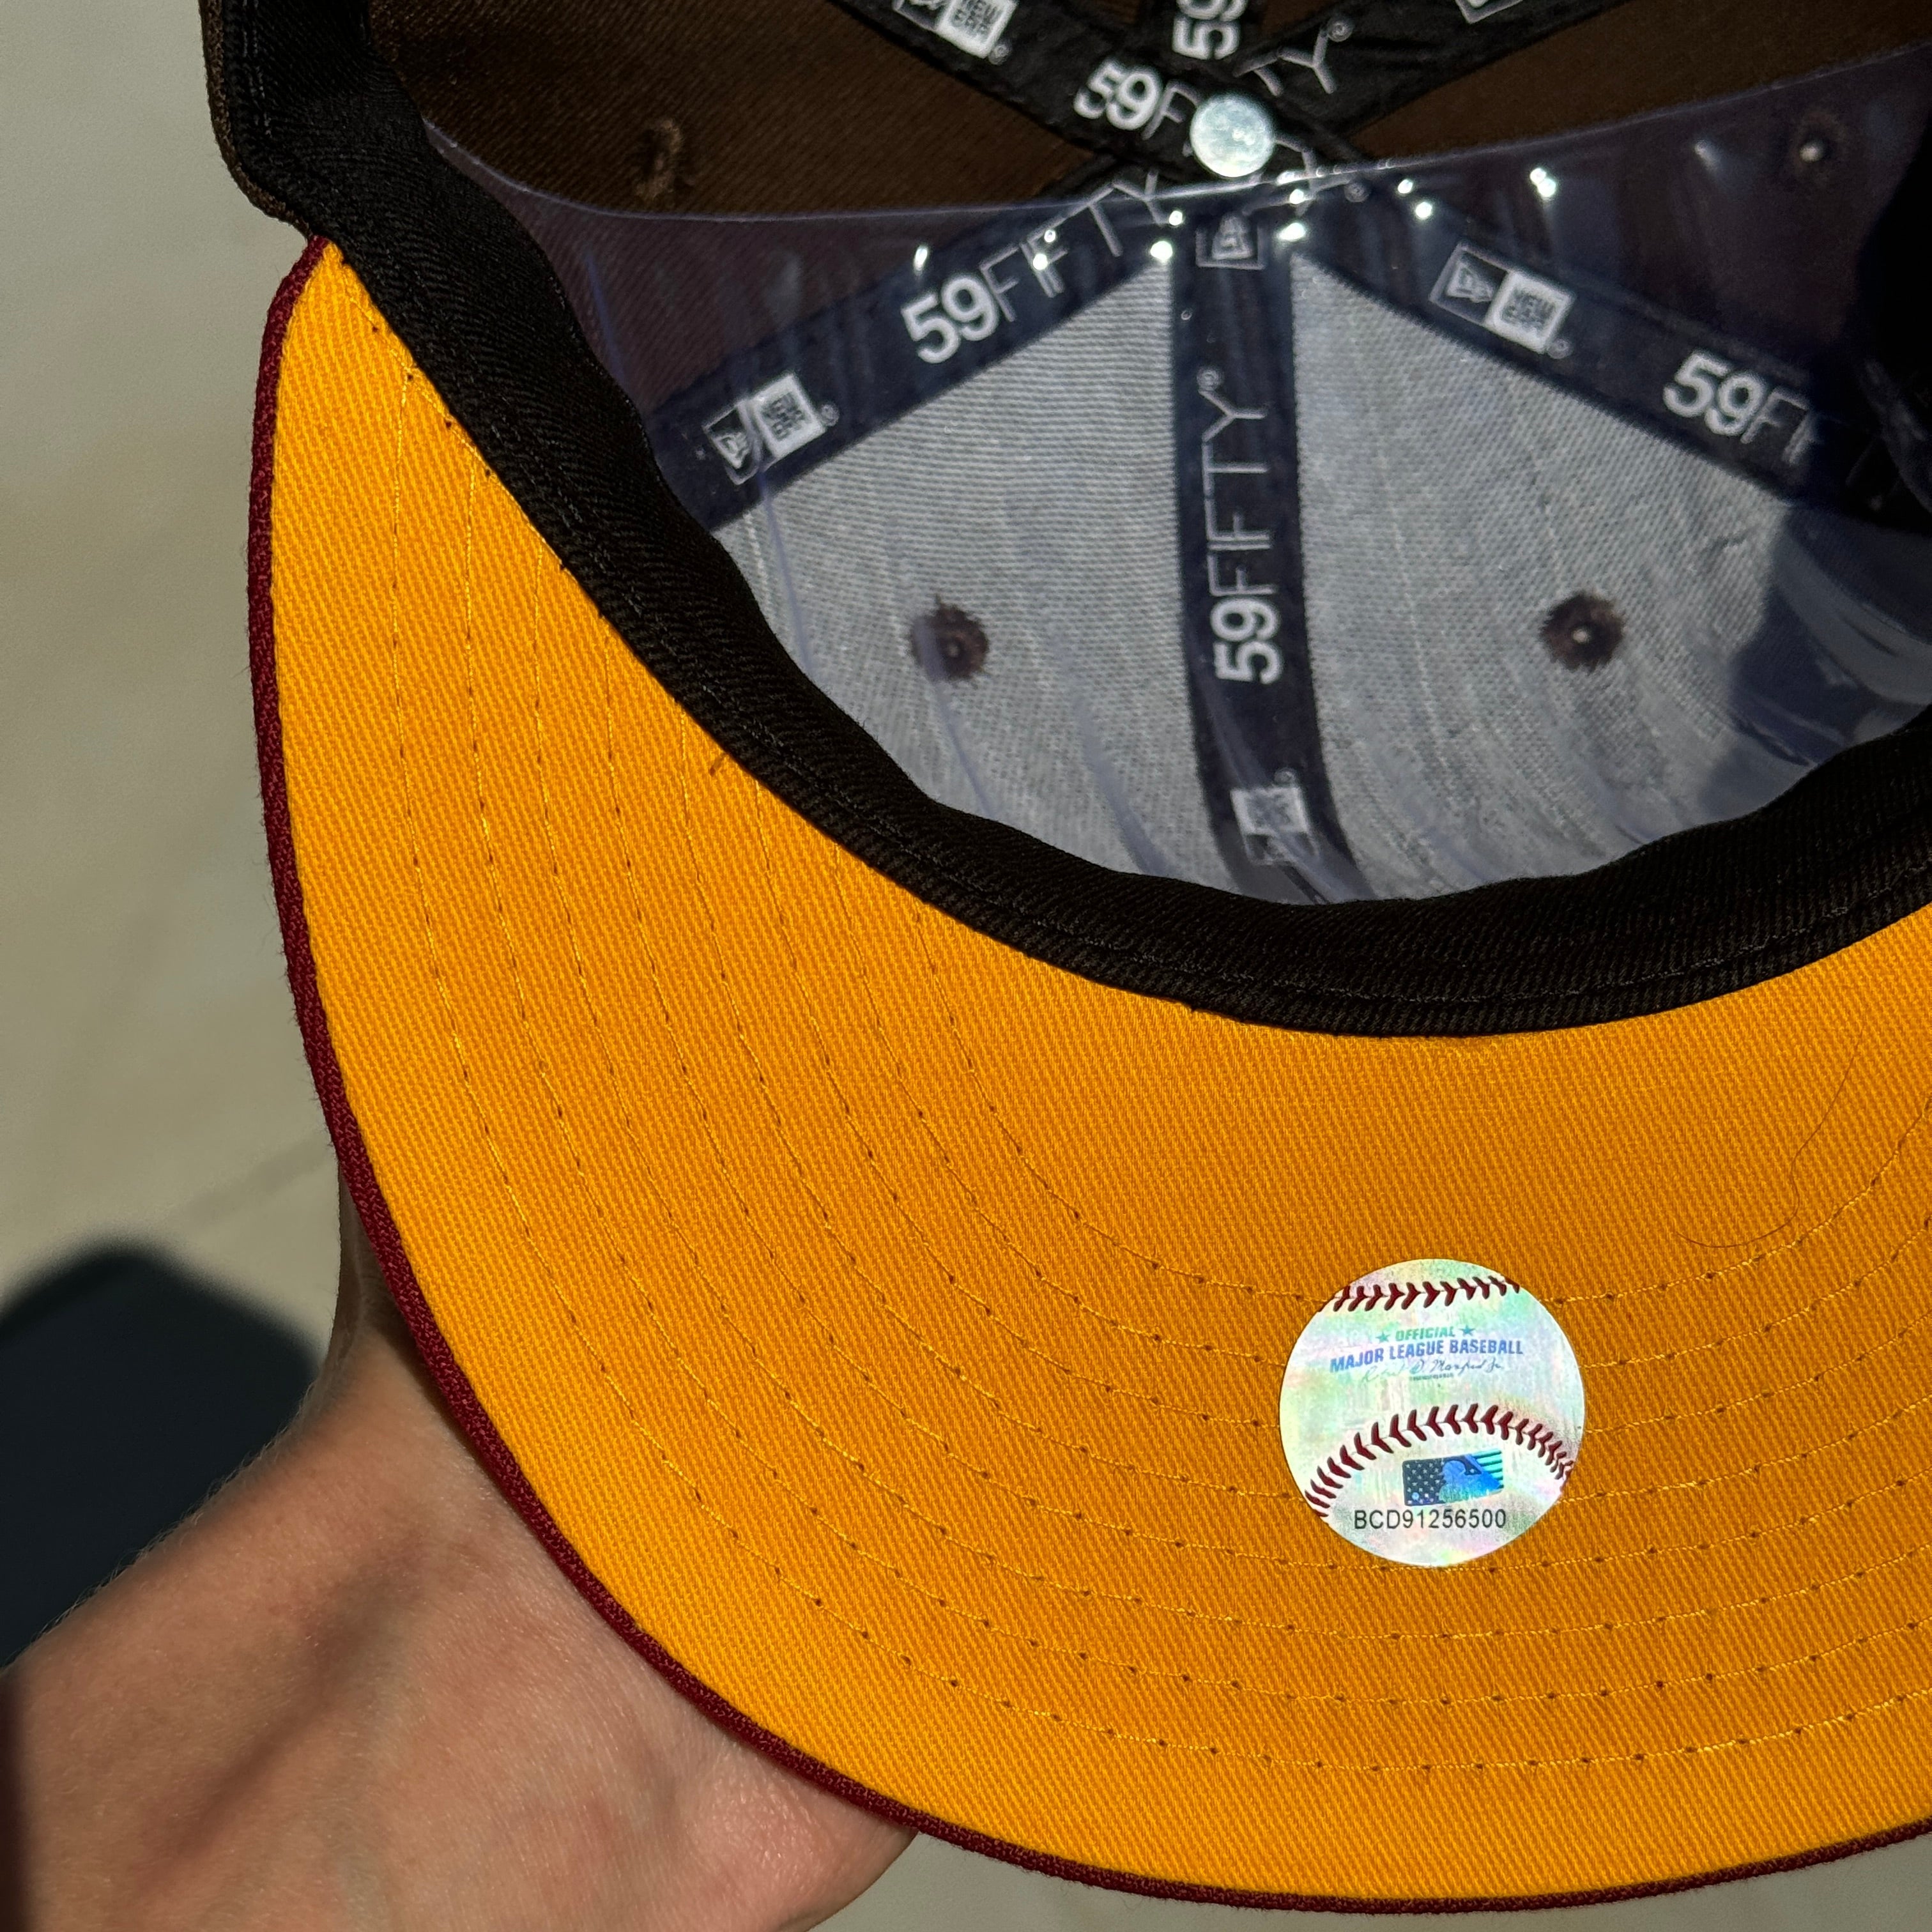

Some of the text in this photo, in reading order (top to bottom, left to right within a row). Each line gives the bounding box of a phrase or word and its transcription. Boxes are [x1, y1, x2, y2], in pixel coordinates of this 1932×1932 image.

[1395, 1326, 1456, 1342] OFFICIAL
[1330, 1347, 1384, 1374] MAJOR
[1389, 1339, 1445, 1360] LEAGUE
[1449, 1338, 1524, 1355] BASEBALL
[1354, 1508, 1506, 1529] BCD91256500
